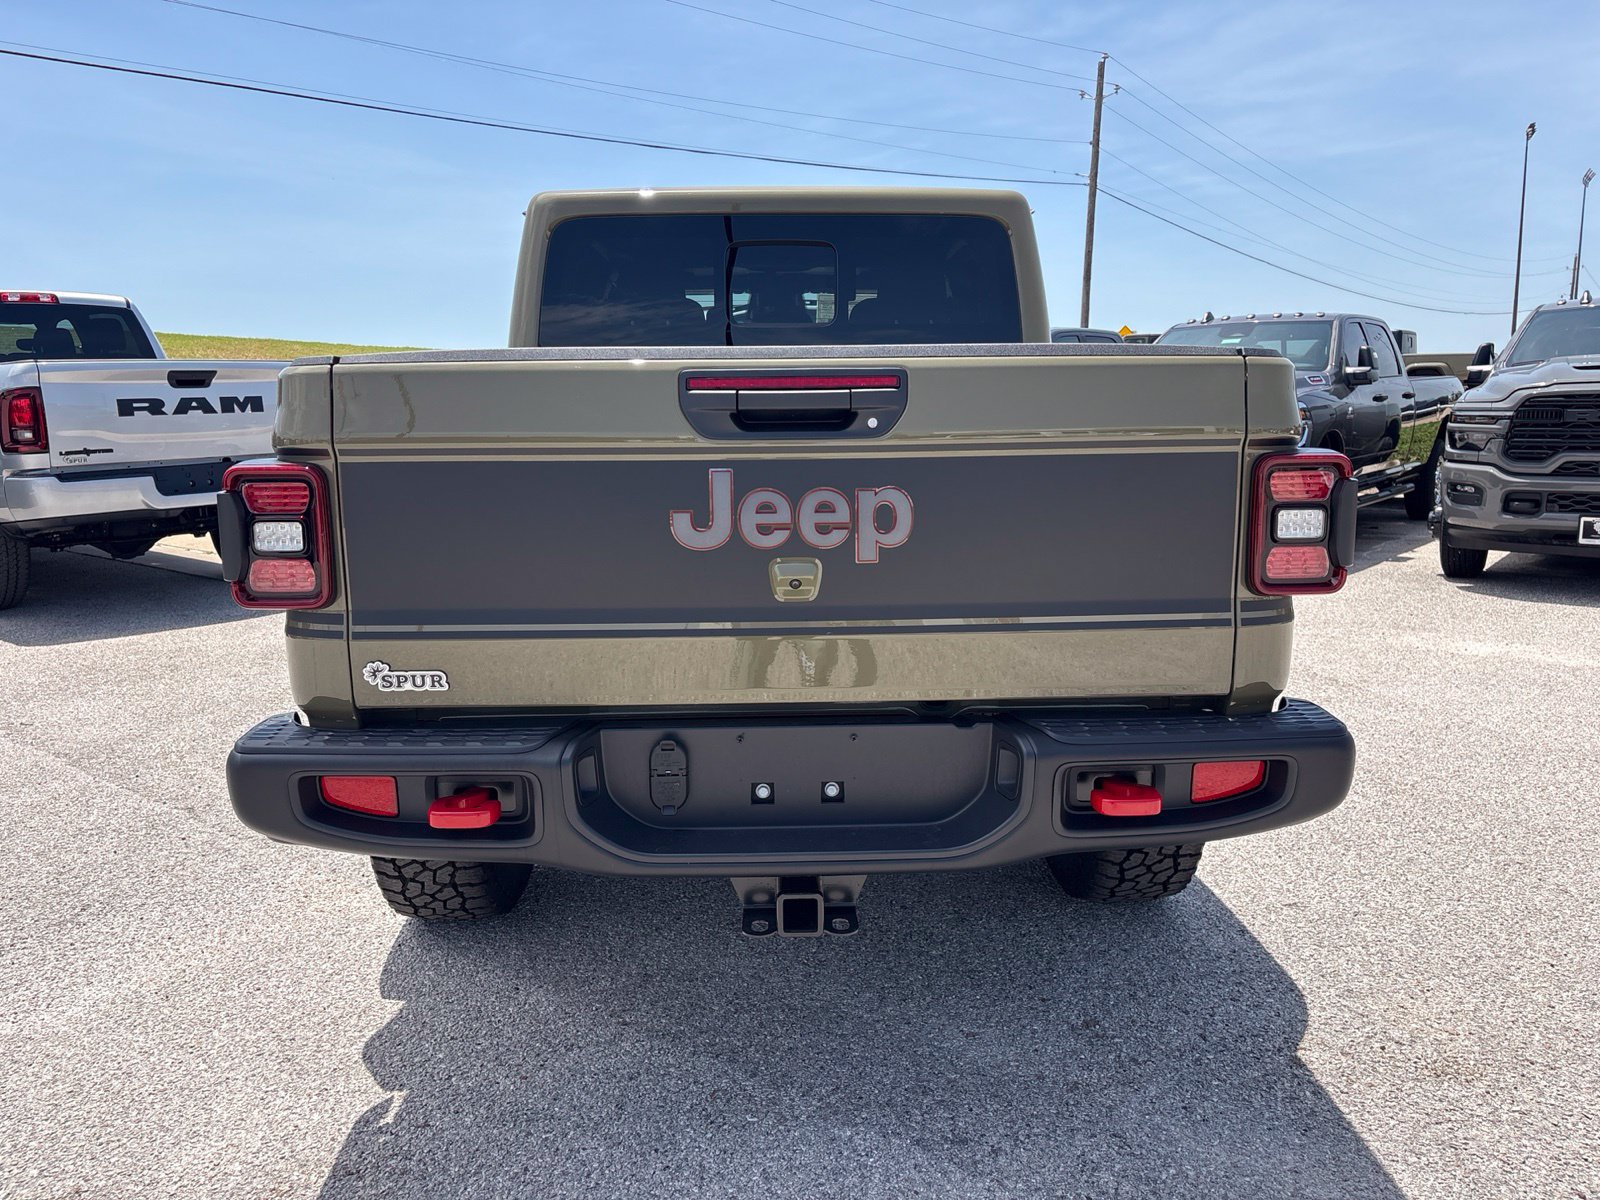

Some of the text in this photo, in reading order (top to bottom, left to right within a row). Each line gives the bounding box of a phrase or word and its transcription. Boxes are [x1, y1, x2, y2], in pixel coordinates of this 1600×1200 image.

[116, 396, 264, 416] RAM
[670, 468, 914, 563] Jeep
[381, 674, 445, 688] SPUR
